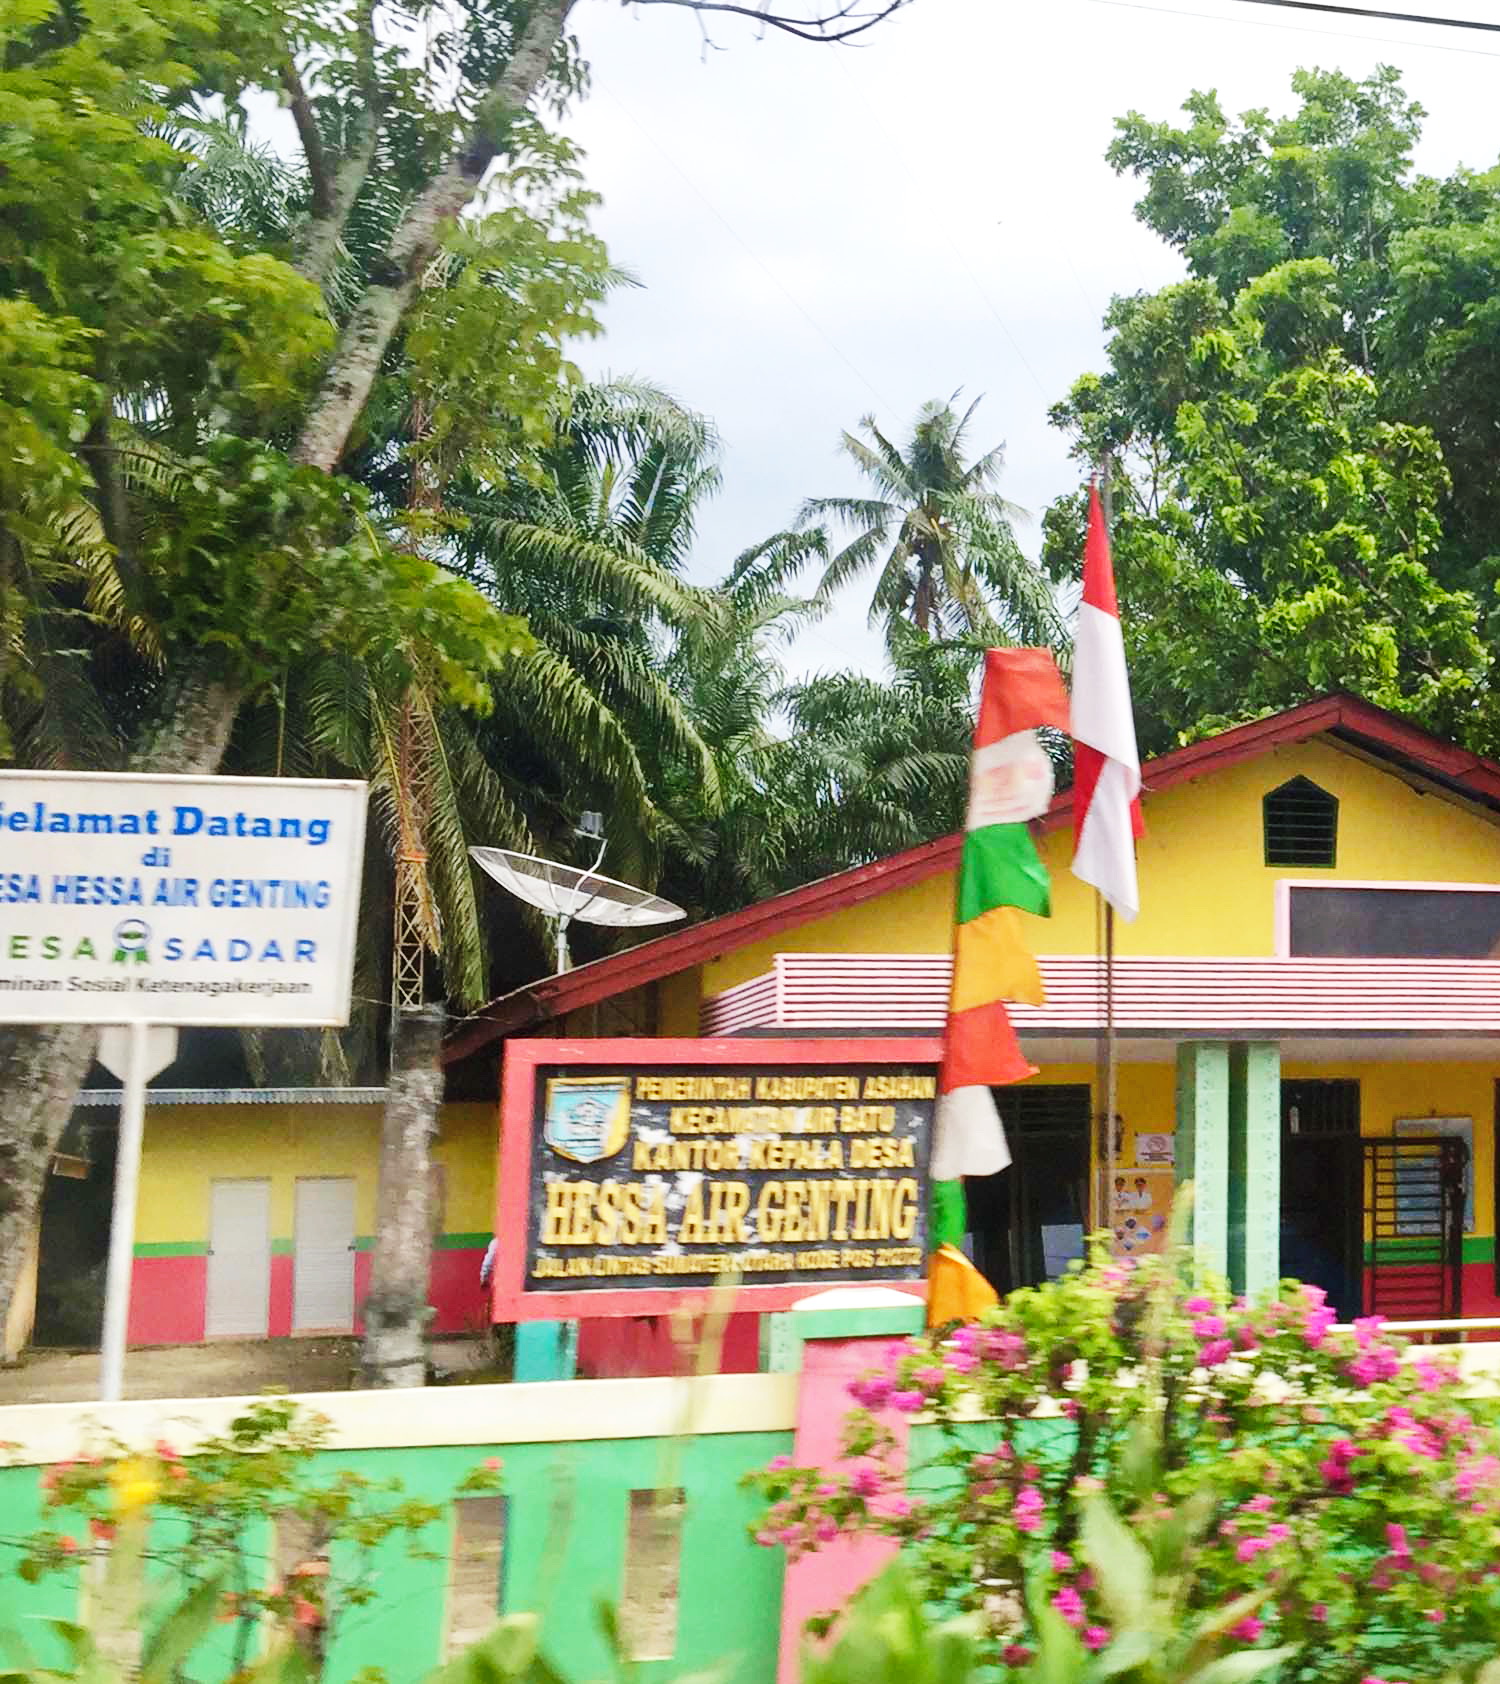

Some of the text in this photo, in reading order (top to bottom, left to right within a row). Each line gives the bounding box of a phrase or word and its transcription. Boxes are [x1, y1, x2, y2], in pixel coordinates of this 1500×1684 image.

[0, 802, 331, 845] elamat Datang
[141, 846, 171, 868] di
[51, 875, 144, 906] HESSA
[152, 878, 199, 907] AIR
[208, 879, 331, 908] GENTING
[163, 937, 318, 963] SADAR
[66, 976, 130, 993] Sosial
[136, 979, 313, 997] Ketenagakerjaan
[636, 1076, 936, 1100] PEMERINTAH KABUPATEN ASAHAN
[669, 1106, 895, 1134] KECAMATAN AIR BATU
[632, 1137, 915, 1170] KANTOR KEPALA DESA
[541, 1177, 919, 1245] HESSA AIR GENTING
[842, 1249, 875, 1268] POS
